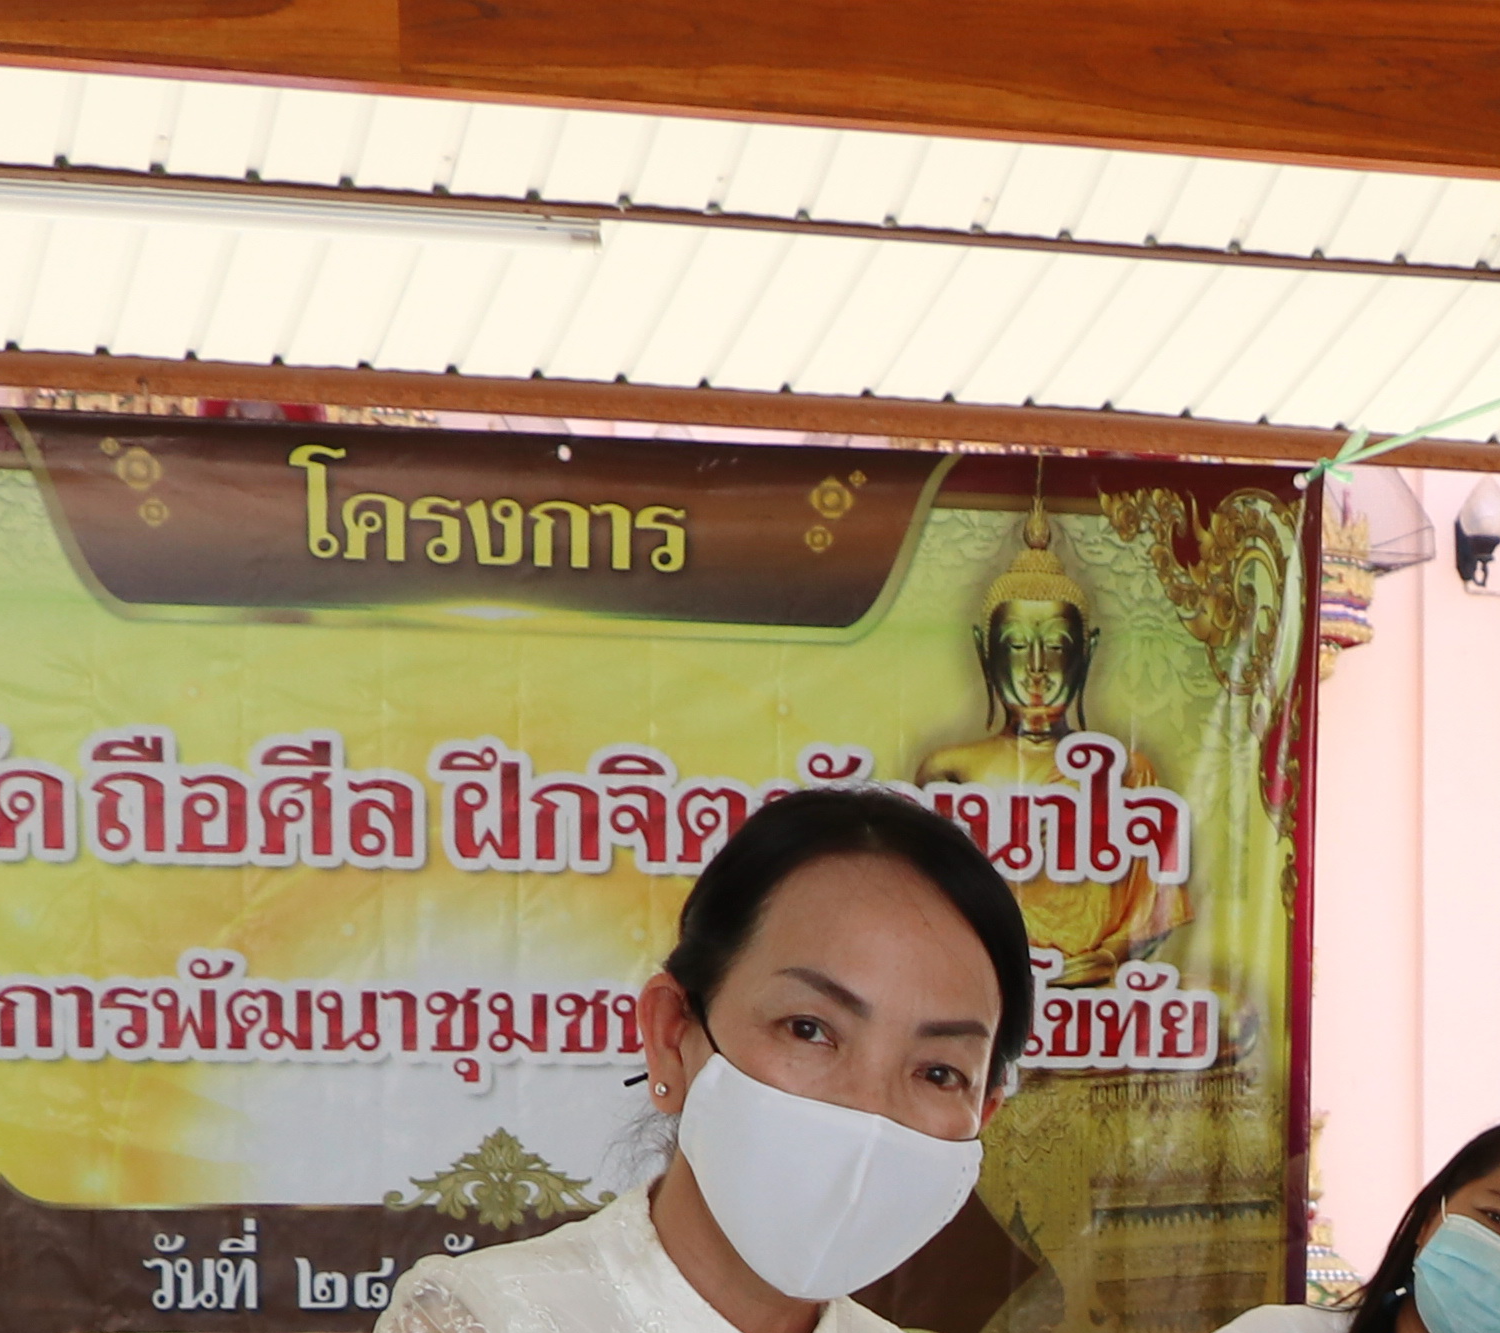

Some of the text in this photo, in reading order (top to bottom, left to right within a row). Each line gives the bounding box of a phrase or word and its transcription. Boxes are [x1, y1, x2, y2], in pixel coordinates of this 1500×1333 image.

[288, 444, 687, 573] โครงการ
[90, 735, 415, 858] ถือศีล
[142, 1218, 395, 1311] วันที่ ๒๘
